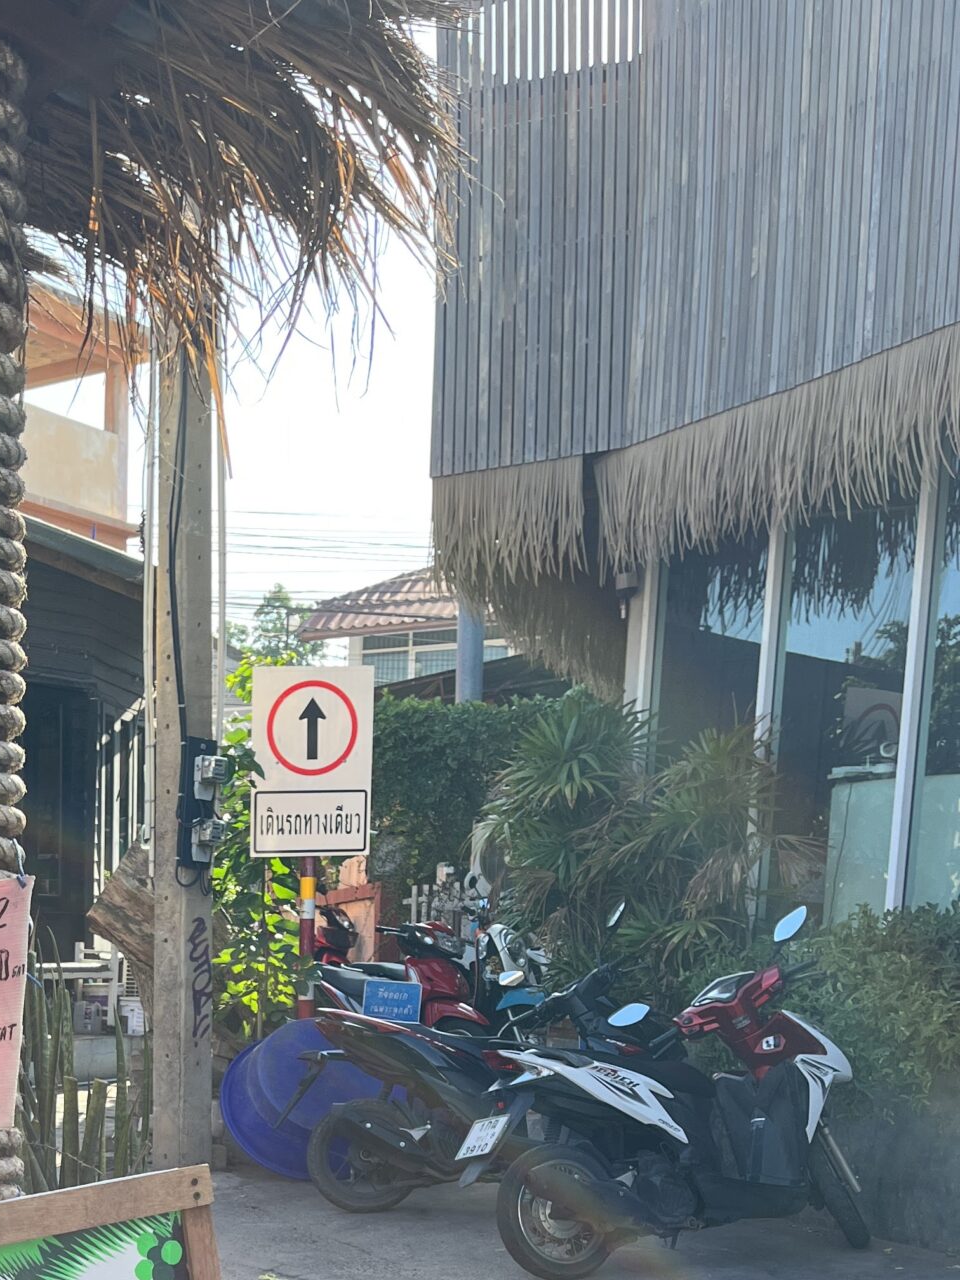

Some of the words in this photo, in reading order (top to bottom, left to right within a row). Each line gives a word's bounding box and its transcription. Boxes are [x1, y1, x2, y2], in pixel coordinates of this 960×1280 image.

[260, 804, 361, 835] เดินรถทางเดียว
